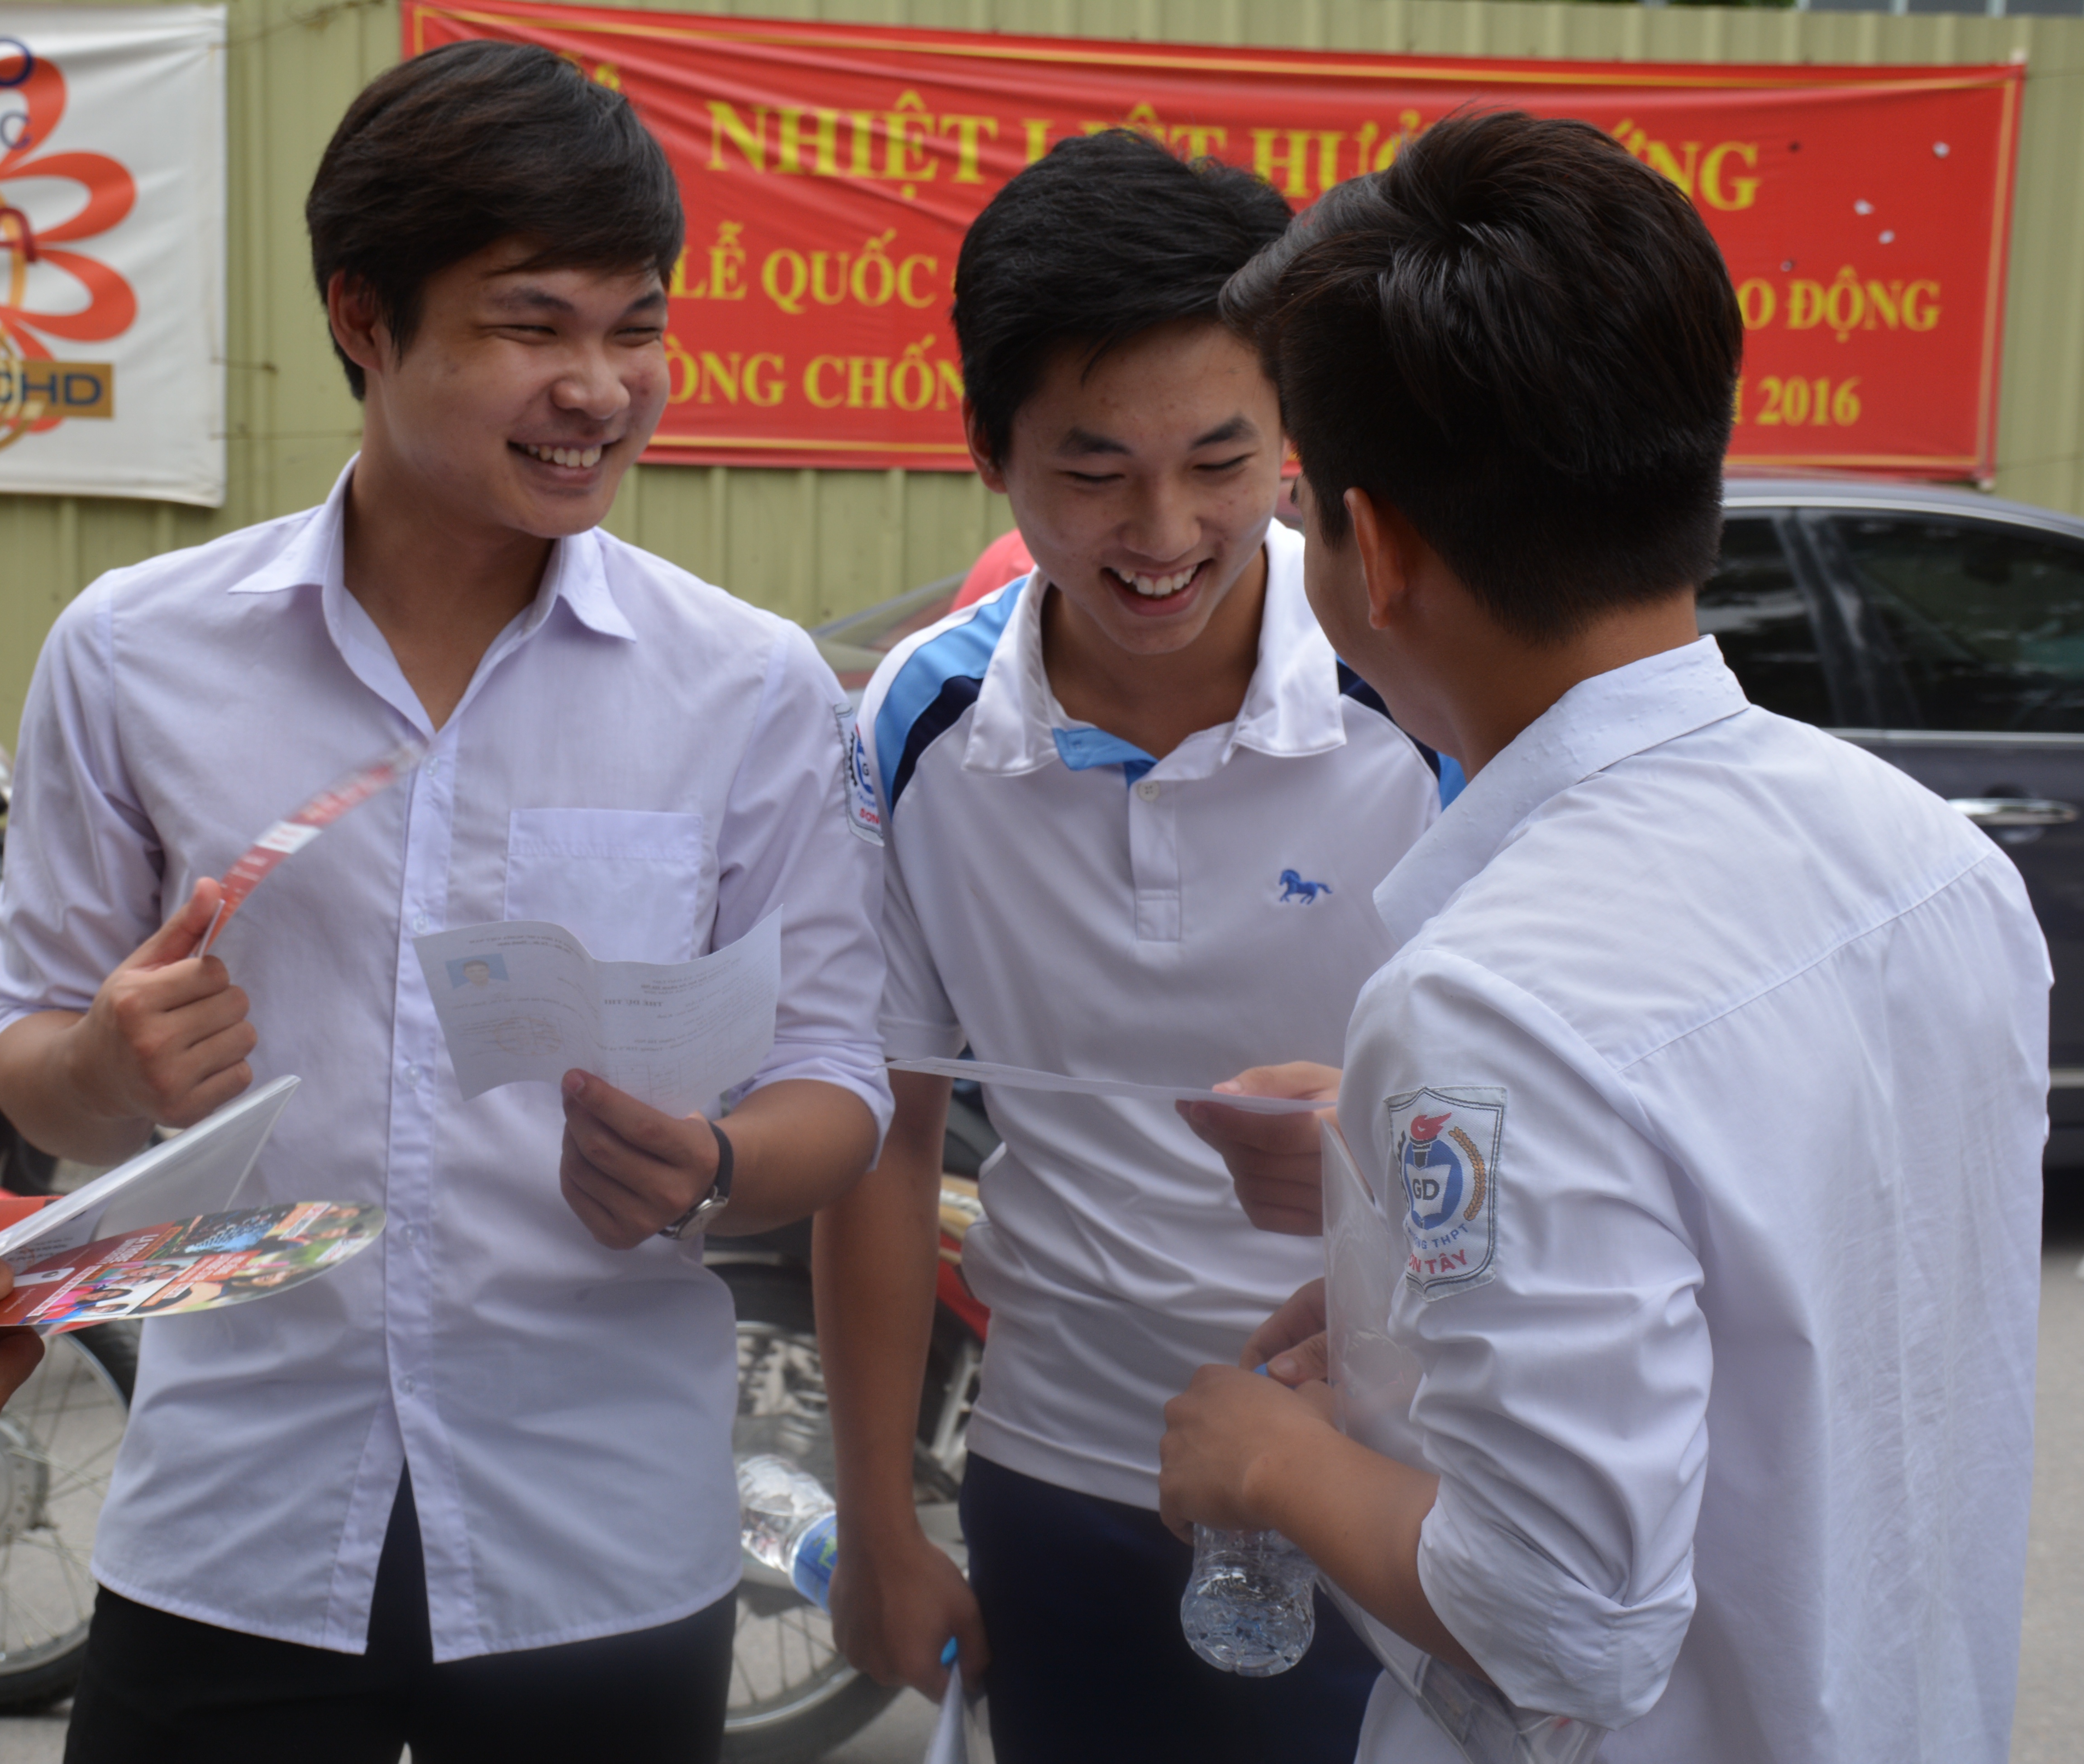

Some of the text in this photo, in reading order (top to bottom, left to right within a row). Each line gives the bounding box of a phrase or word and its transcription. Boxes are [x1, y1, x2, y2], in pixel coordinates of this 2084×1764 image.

[705, 90, 999, 200] NHIỆT
[1612, 118, 1761, 210] NG
[761, 228, 938, 314] QUỐC
[1786, 264, 1941, 343] ĐỘNG
[1755, 374, 1862, 427] 2016
[1412, 1178, 1440, 1200] GD
[1431, 1223, 1468, 1248] THPT
[1425, 1249, 1467, 1274] TÂY
